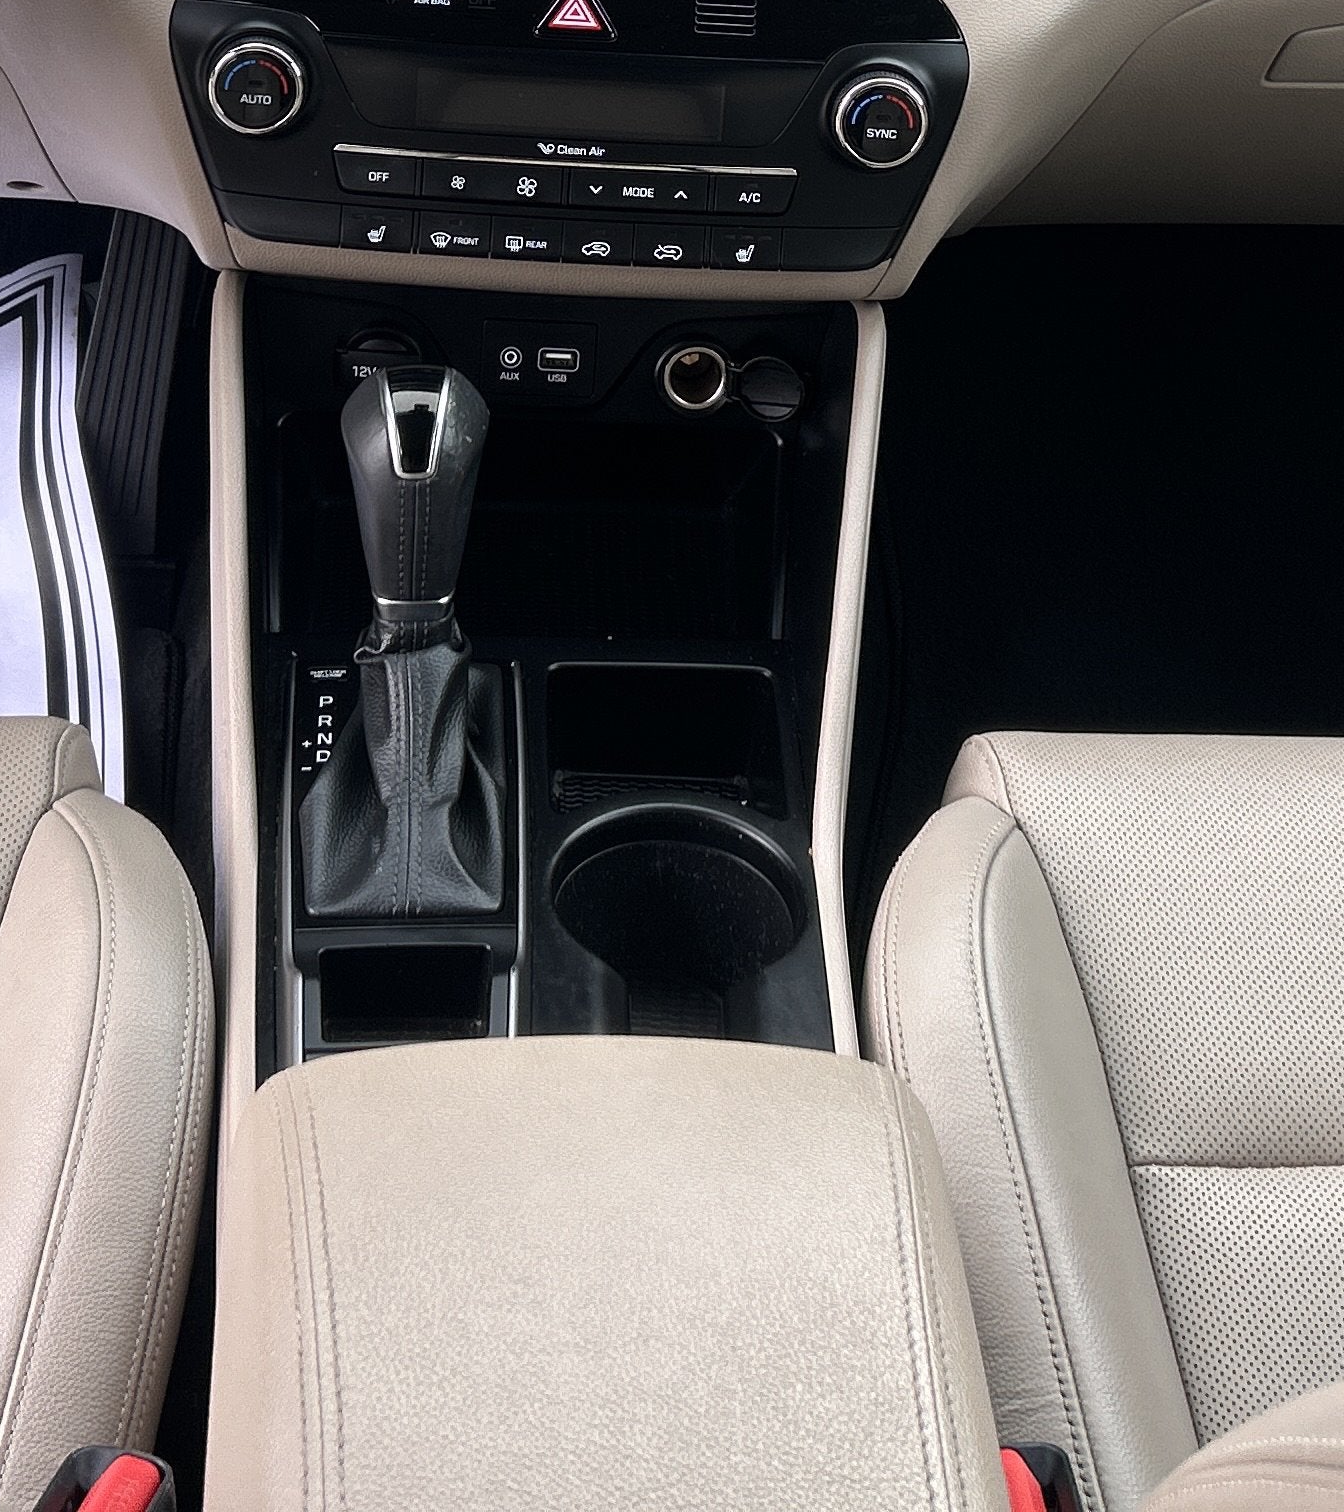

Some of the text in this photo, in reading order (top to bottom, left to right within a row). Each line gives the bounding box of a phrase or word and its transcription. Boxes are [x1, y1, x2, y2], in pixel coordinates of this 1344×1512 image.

[240, 94, 272, 106] AUTO
[866, 128, 897, 139] SYNC
[557, 145, 606, 157] Clean Air
[368, 171, 390, 182] OFF
[623, 186, 655, 198] MODE
[739, 192, 761, 204] A/C
[453, 236, 479, 247] FRONT
[526, 239, 547, 250] REAR
[499, 371, 520, 381] AUX
[547, 373, 567, 383] USB
[319, 695, 333, 707] P
[318, 715, 332, 727] R
[317, 732, 333, 745] N
[316, 750, 331, 762] D
